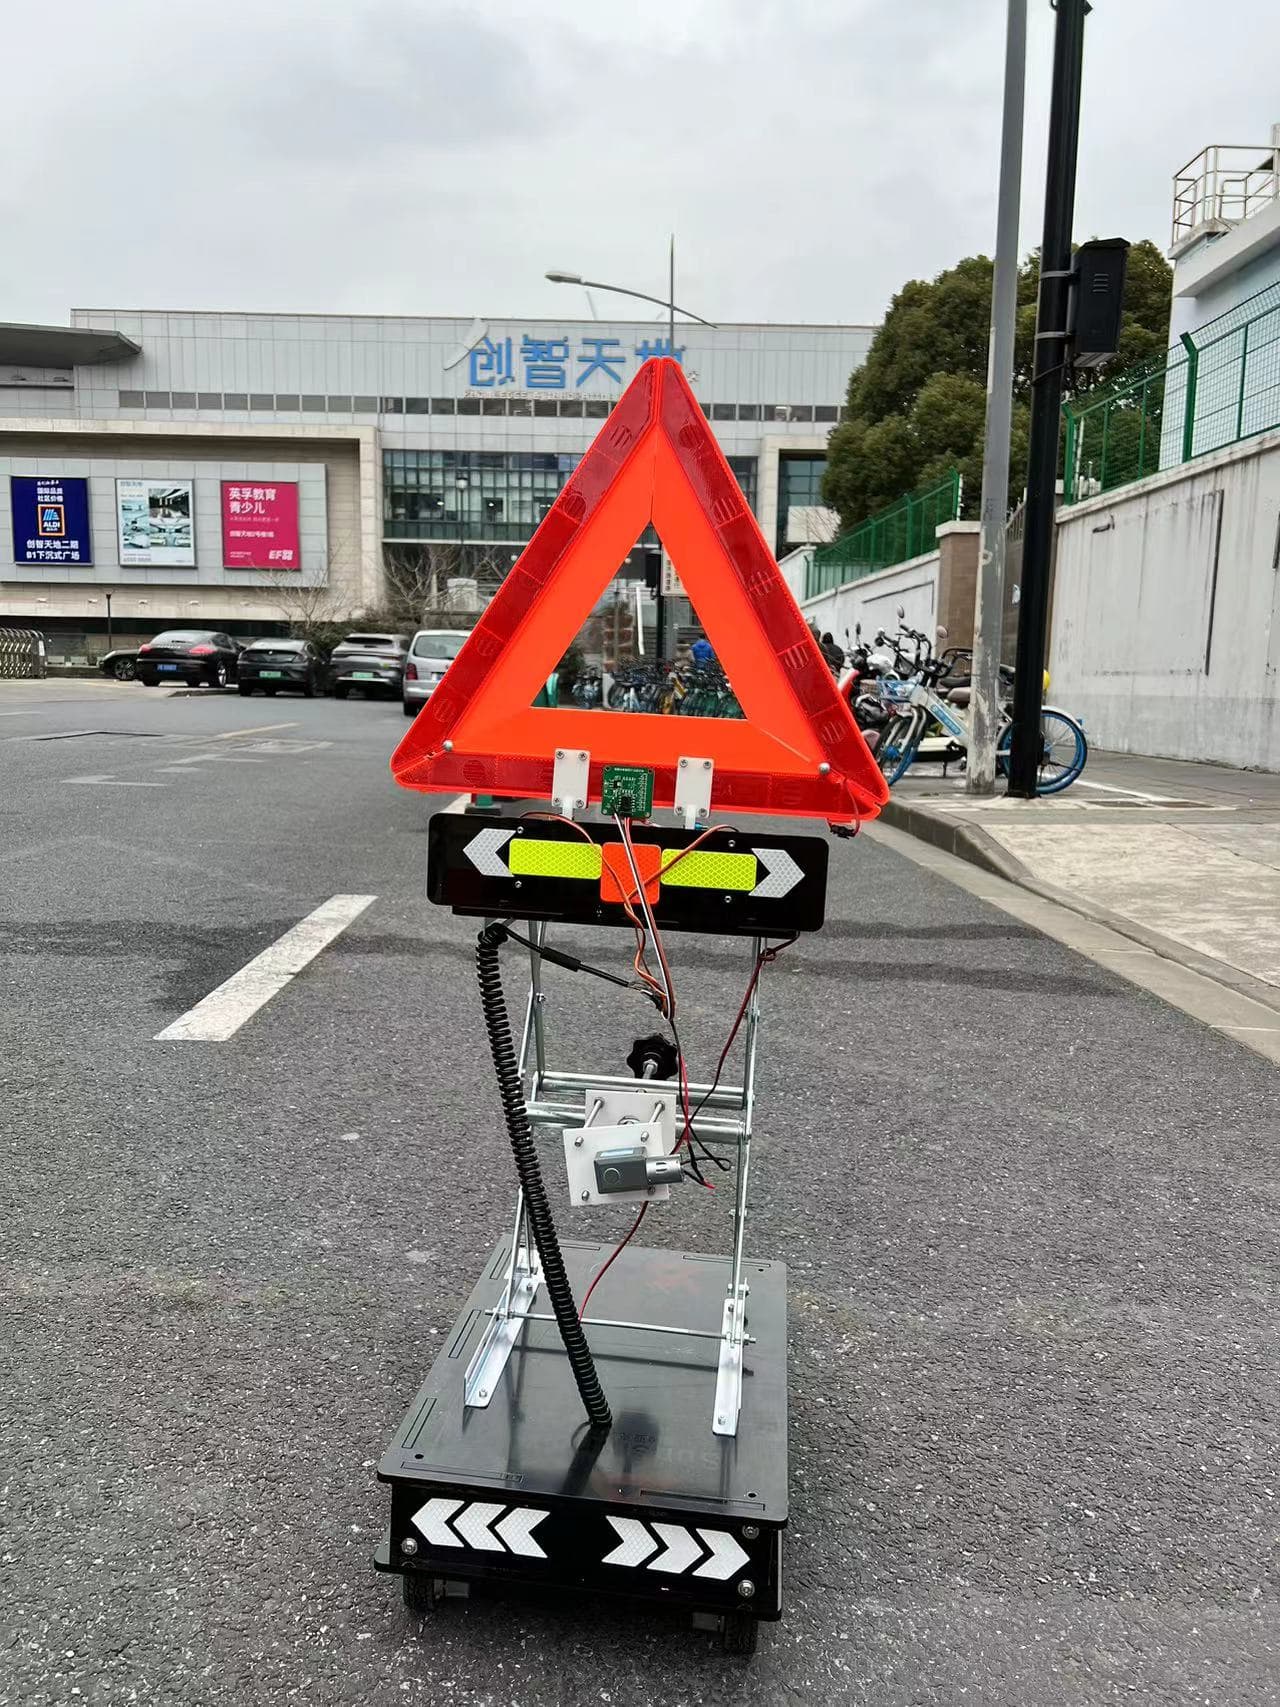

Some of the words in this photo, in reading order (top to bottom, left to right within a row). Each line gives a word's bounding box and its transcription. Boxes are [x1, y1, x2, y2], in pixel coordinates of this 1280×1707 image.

[229, 487, 276, 501] 英孚教育
[229, 501, 265, 514] 青少儿
[26, 539, 79, 549] 创智天地二期
[26, 551, 80, 560] B1下沉式广场
